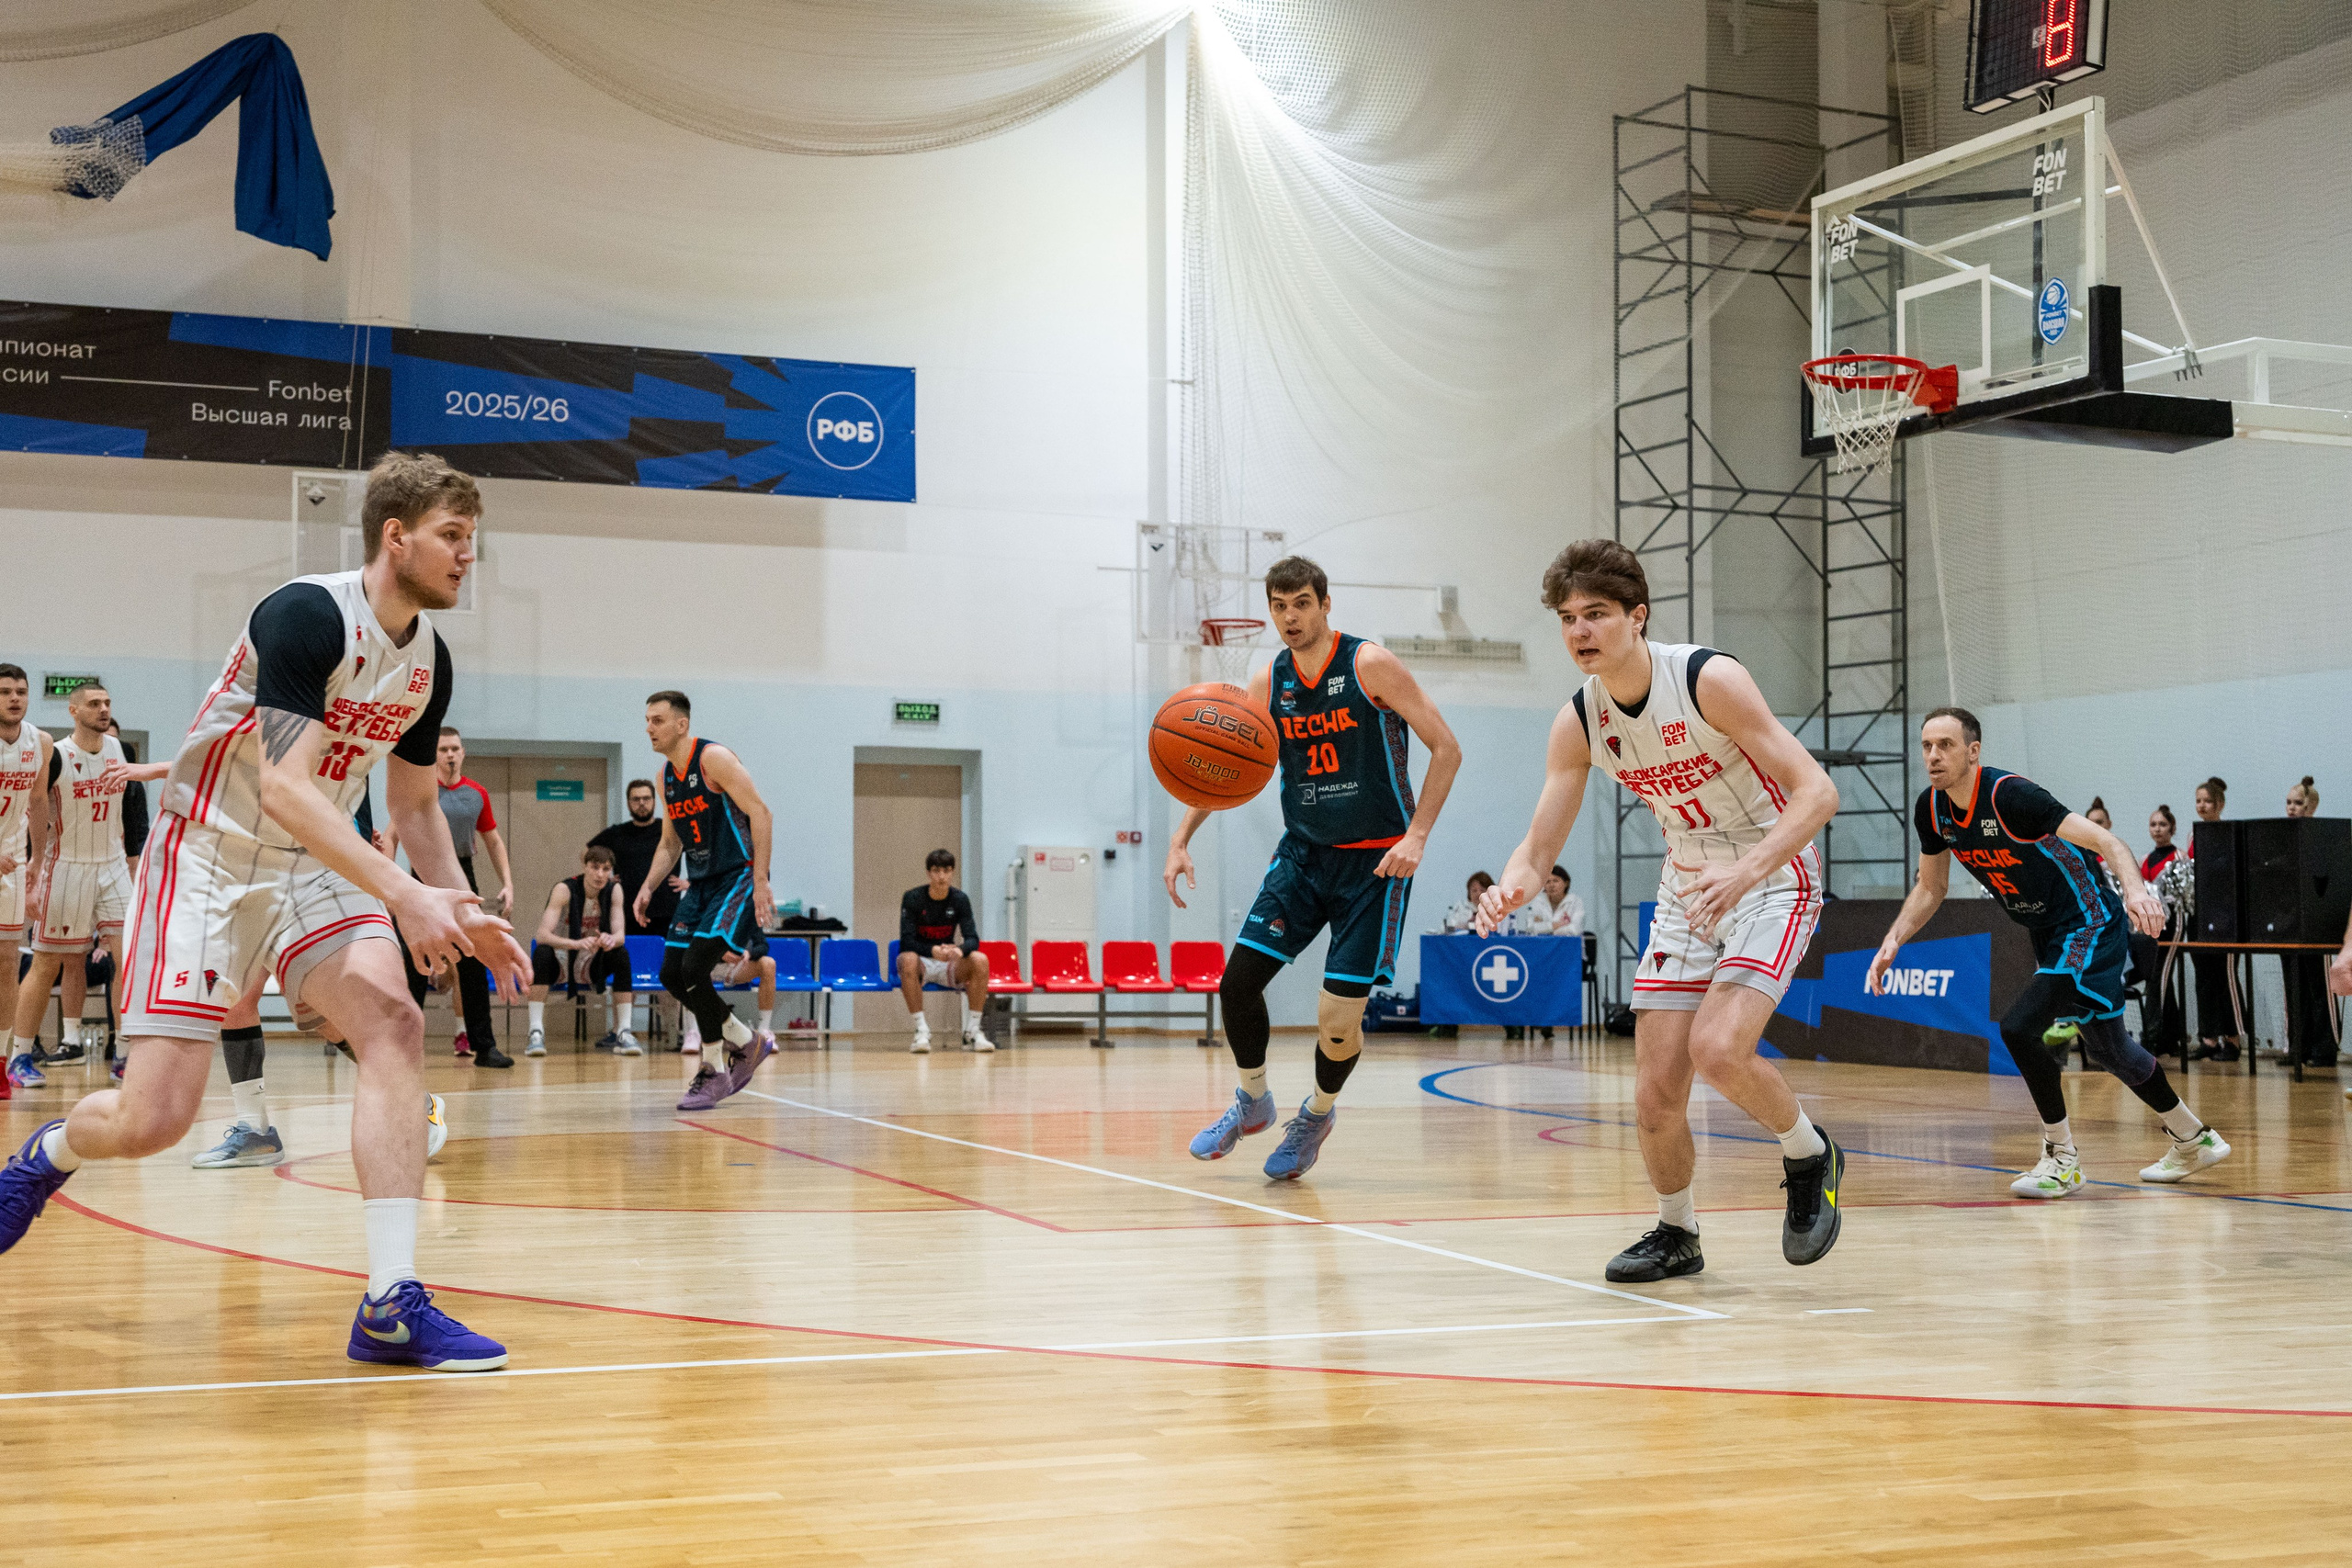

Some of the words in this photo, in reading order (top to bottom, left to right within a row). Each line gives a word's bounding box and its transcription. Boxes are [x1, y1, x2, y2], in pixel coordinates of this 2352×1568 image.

[2032, 148, 2067, 176] FON
[2032, 170, 2066, 197] BET
[1831, 220, 1858, 245] FON
[1831, 239, 1859, 264] BET
[3, 368, 49, 384] сии
[268, 380, 352, 403] Fonbet
[192, 402, 288, 426] Высшая
[298, 413, 352, 431] лига
[446, 390, 569, 422] 2025/26
[817, 418, 875, 443] РФБ
[1329, 675, 1345, 687] FON
[1329, 683, 1345, 695] BET
[1661, 721, 1686, 736] FON
[1664, 731, 1686, 746] BET
[1183, 753, 1240, 780] JB-1000
[1306, 742, 1340, 775] 10
[1318, 781, 1359, 793] НАДЕЖДА
[92, 800, 109, 822] 27
[690, 819, 702, 843] 3
[1981, 818, 1996, 828] FON
[1984, 828, 1998, 837] BET
